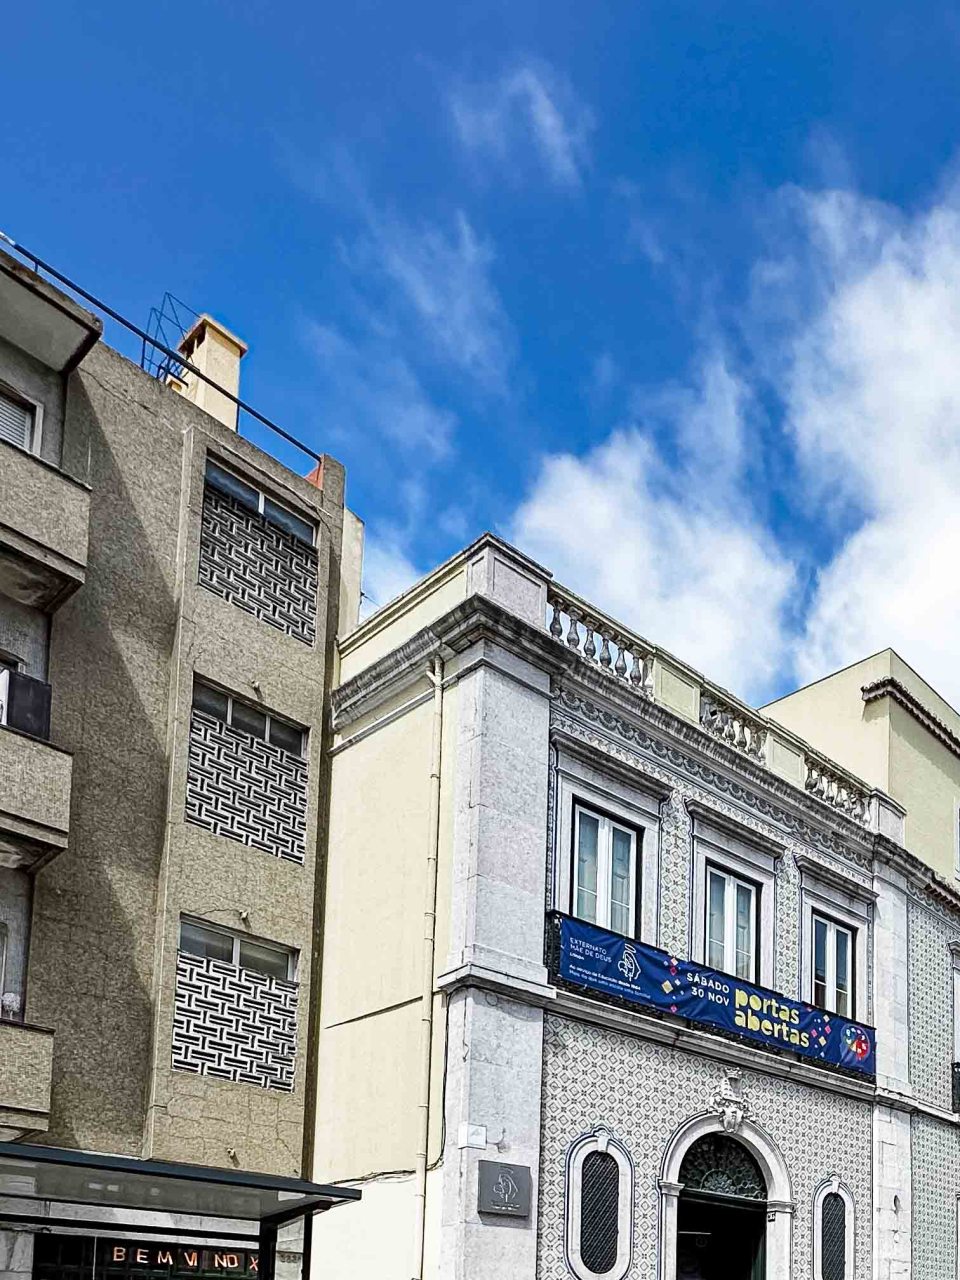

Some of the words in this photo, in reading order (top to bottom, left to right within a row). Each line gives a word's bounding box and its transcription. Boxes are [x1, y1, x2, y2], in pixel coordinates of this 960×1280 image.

[570, 937, 607, 955] EXTERNATO
[570, 944, 584, 954] MÃE
[585, 949, 593, 957] DE
[595, 951, 612, 963] DEUS
[686, 972, 730, 994] SÁBADO
[691, 986, 704, 998] 30
[708, 992, 730, 1007] NOV
[735, 988, 800, 1025] portas
[734, 1009, 810, 1047] abertas
